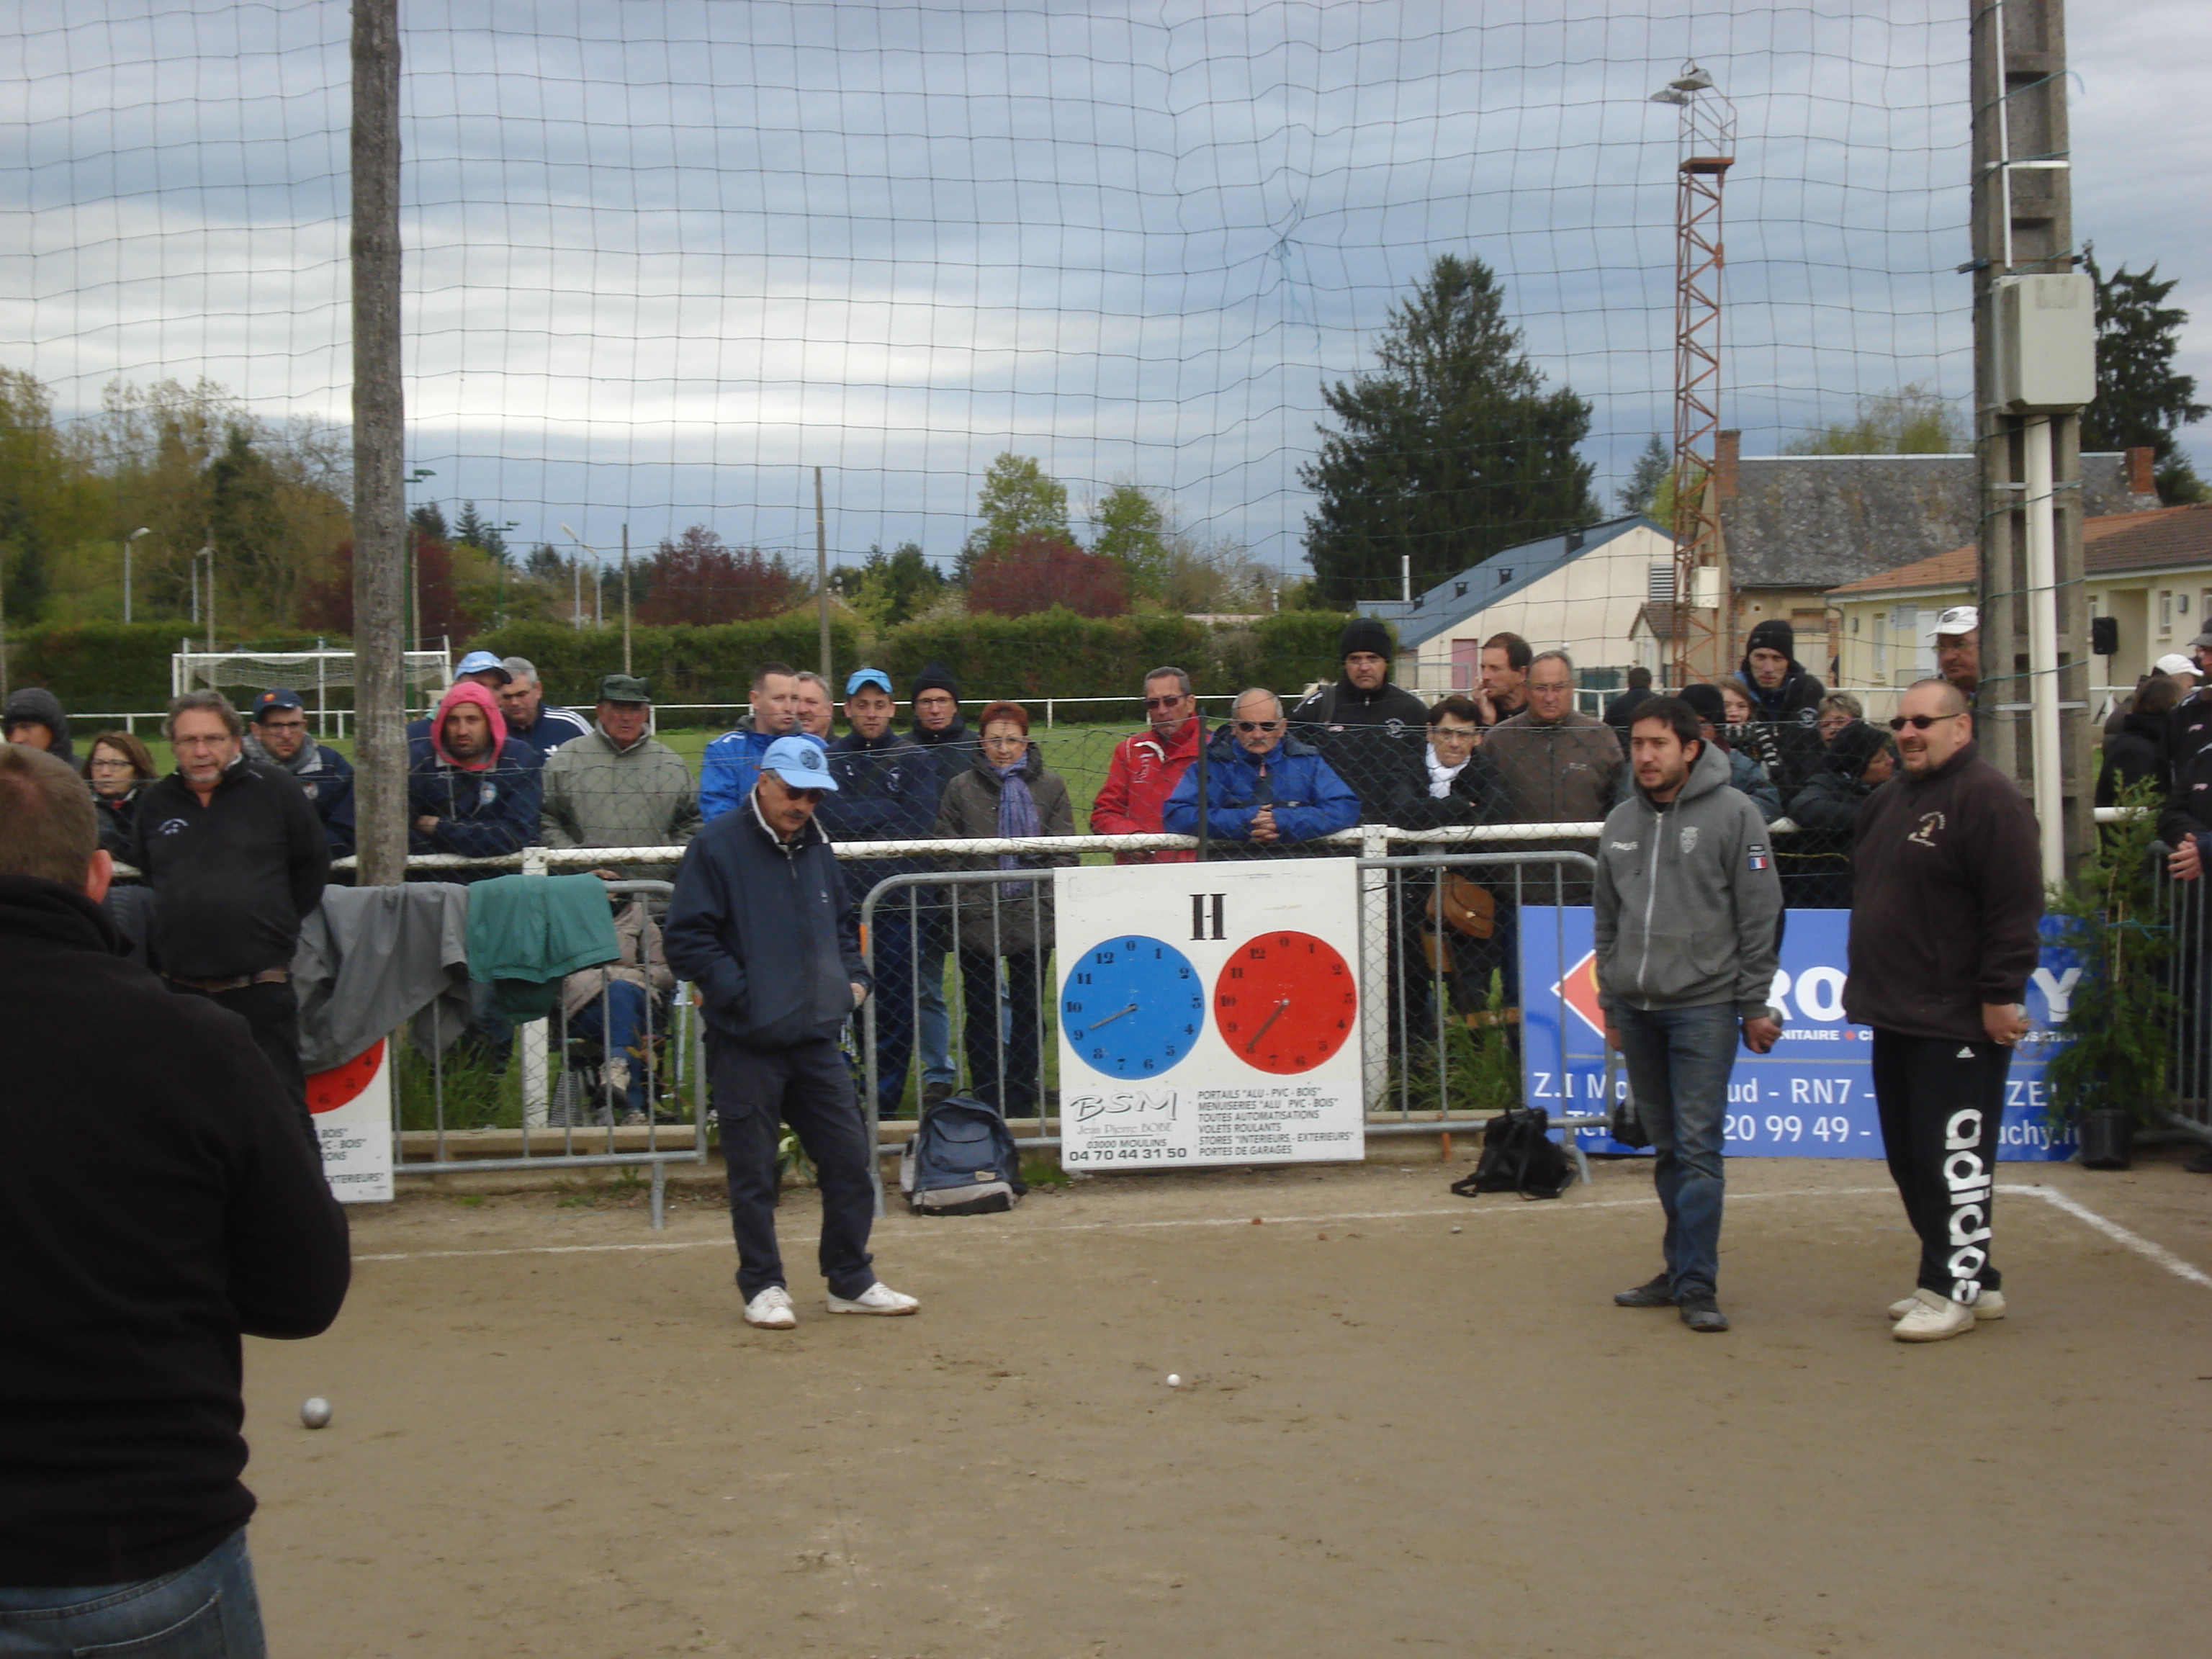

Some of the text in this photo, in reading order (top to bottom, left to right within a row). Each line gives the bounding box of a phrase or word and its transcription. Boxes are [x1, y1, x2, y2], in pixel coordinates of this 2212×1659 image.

[1189, 893, 1227, 940] H
[1126, 940, 1136, 951] 0
[1280, 937, 1290, 948] 0
[1155, 948, 1161, 959] 1
[1249, 948, 1266, 959] 12
[1308, 943, 1315, 954] 1
[1096, 952, 1115, 964] 12
[1179, 967, 1190, 979] 2
[1231, 967, 1244, 979] 11
[1332, 963, 1342, 975] 2
[1076, 973, 1092, 984] 11
[1192, 996, 1202, 1009] 3
[1220, 996, 1236, 1007] 10
[1344, 992, 1353, 1004] 3
[1066, 1001, 1082, 1012] 10
[1184, 1023, 1194, 1035] 4
[1228, 1022, 1238, 1033] 9
[1336, 1019, 1346, 1030] 4
[1074, 1029, 1084, 1040] 9
[1166, 1044, 1175, 1056] 5
[1318, 1040, 1328, 1051] 5
[1093, 1048, 1104, 1059] 8
[1117, 1057, 1125, 1070] 7
[1143, 1058, 1154, 1070] 6
[1269, 1054, 1278, 1066] 7
[1296, 1056, 1306, 1066] 6
[1197, 1089, 1239, 1100] PORTAILS
[1791, 1079, 1852, 1104] RN7
[1070, 1090, 1178, 1123] BSM
[1197, 1101, 1256, 1111] MENUISERIES
[1198, 1110, 1320, 1122] TOUTES AUTOMATISATIONS
[1197, 1123, 1282, 1133] VOLETS ROULANTS
[1766, 1115, 1802, 1141] 99
[1812, 1117, 1849, 1143] 49
[1087, 1138, 1167, 1149] 03000 MOULINS
[1199, 1136, 1232, 1145] STORES
[1070, 1148, 1187, 1161] 04 70 44 31 50
[1199, 1145, 1292, 1156] PORTES DE GARAGES
[1943, 1108, 1992, 1305] adidas
